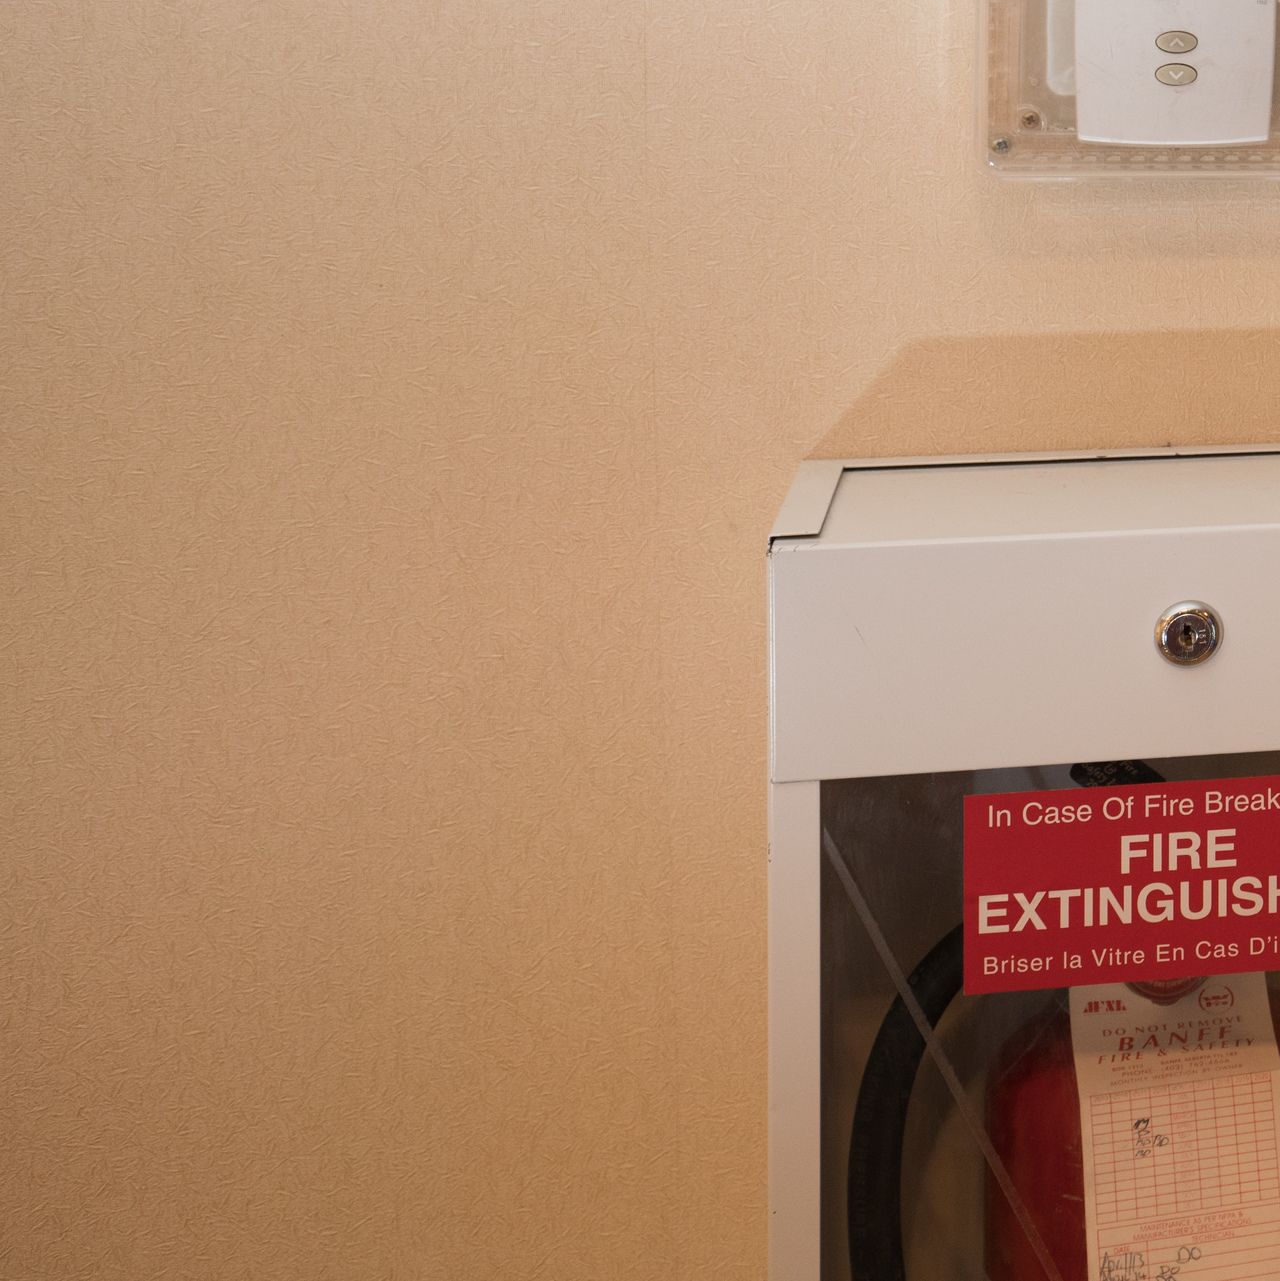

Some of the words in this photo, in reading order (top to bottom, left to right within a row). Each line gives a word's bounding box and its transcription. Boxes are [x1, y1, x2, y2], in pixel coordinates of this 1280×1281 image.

[989, 806, 1010, 827] In
[1023, 802, 1092, 825] Case
[1103, 796, 1133, 820] Of
[1146, 795, 1193, 817] Fire
[1206, 788, 1280, 813] Break
[1121, 829, 1236, 874] FIRE
[984, 957, 1053, 974] Briser
[1064, 952, 1082, 968] la
[1092, 949, 1144, 966] Vitre
[1157, 944, 1184, 962] En
[1196, 941, 1238, 959] Cas
[1102, 1027, 1126, 1037] DO
[1135, 1023, 1168, 1034] NOT
[1177, 1015, 1243, 1030] REMOVE
[1117, 1025, 1233, 1052] BANFF
[1097, 1051, 1145, 1065] FIRE
[1157, 1048, 1168, 1057] &
[1181, 1037, 1256, 1053] SAFETY
[1113, 1245, 1131, 1254] DATE
[1191, 1231, 1236, 1242] TECHNICIAN
